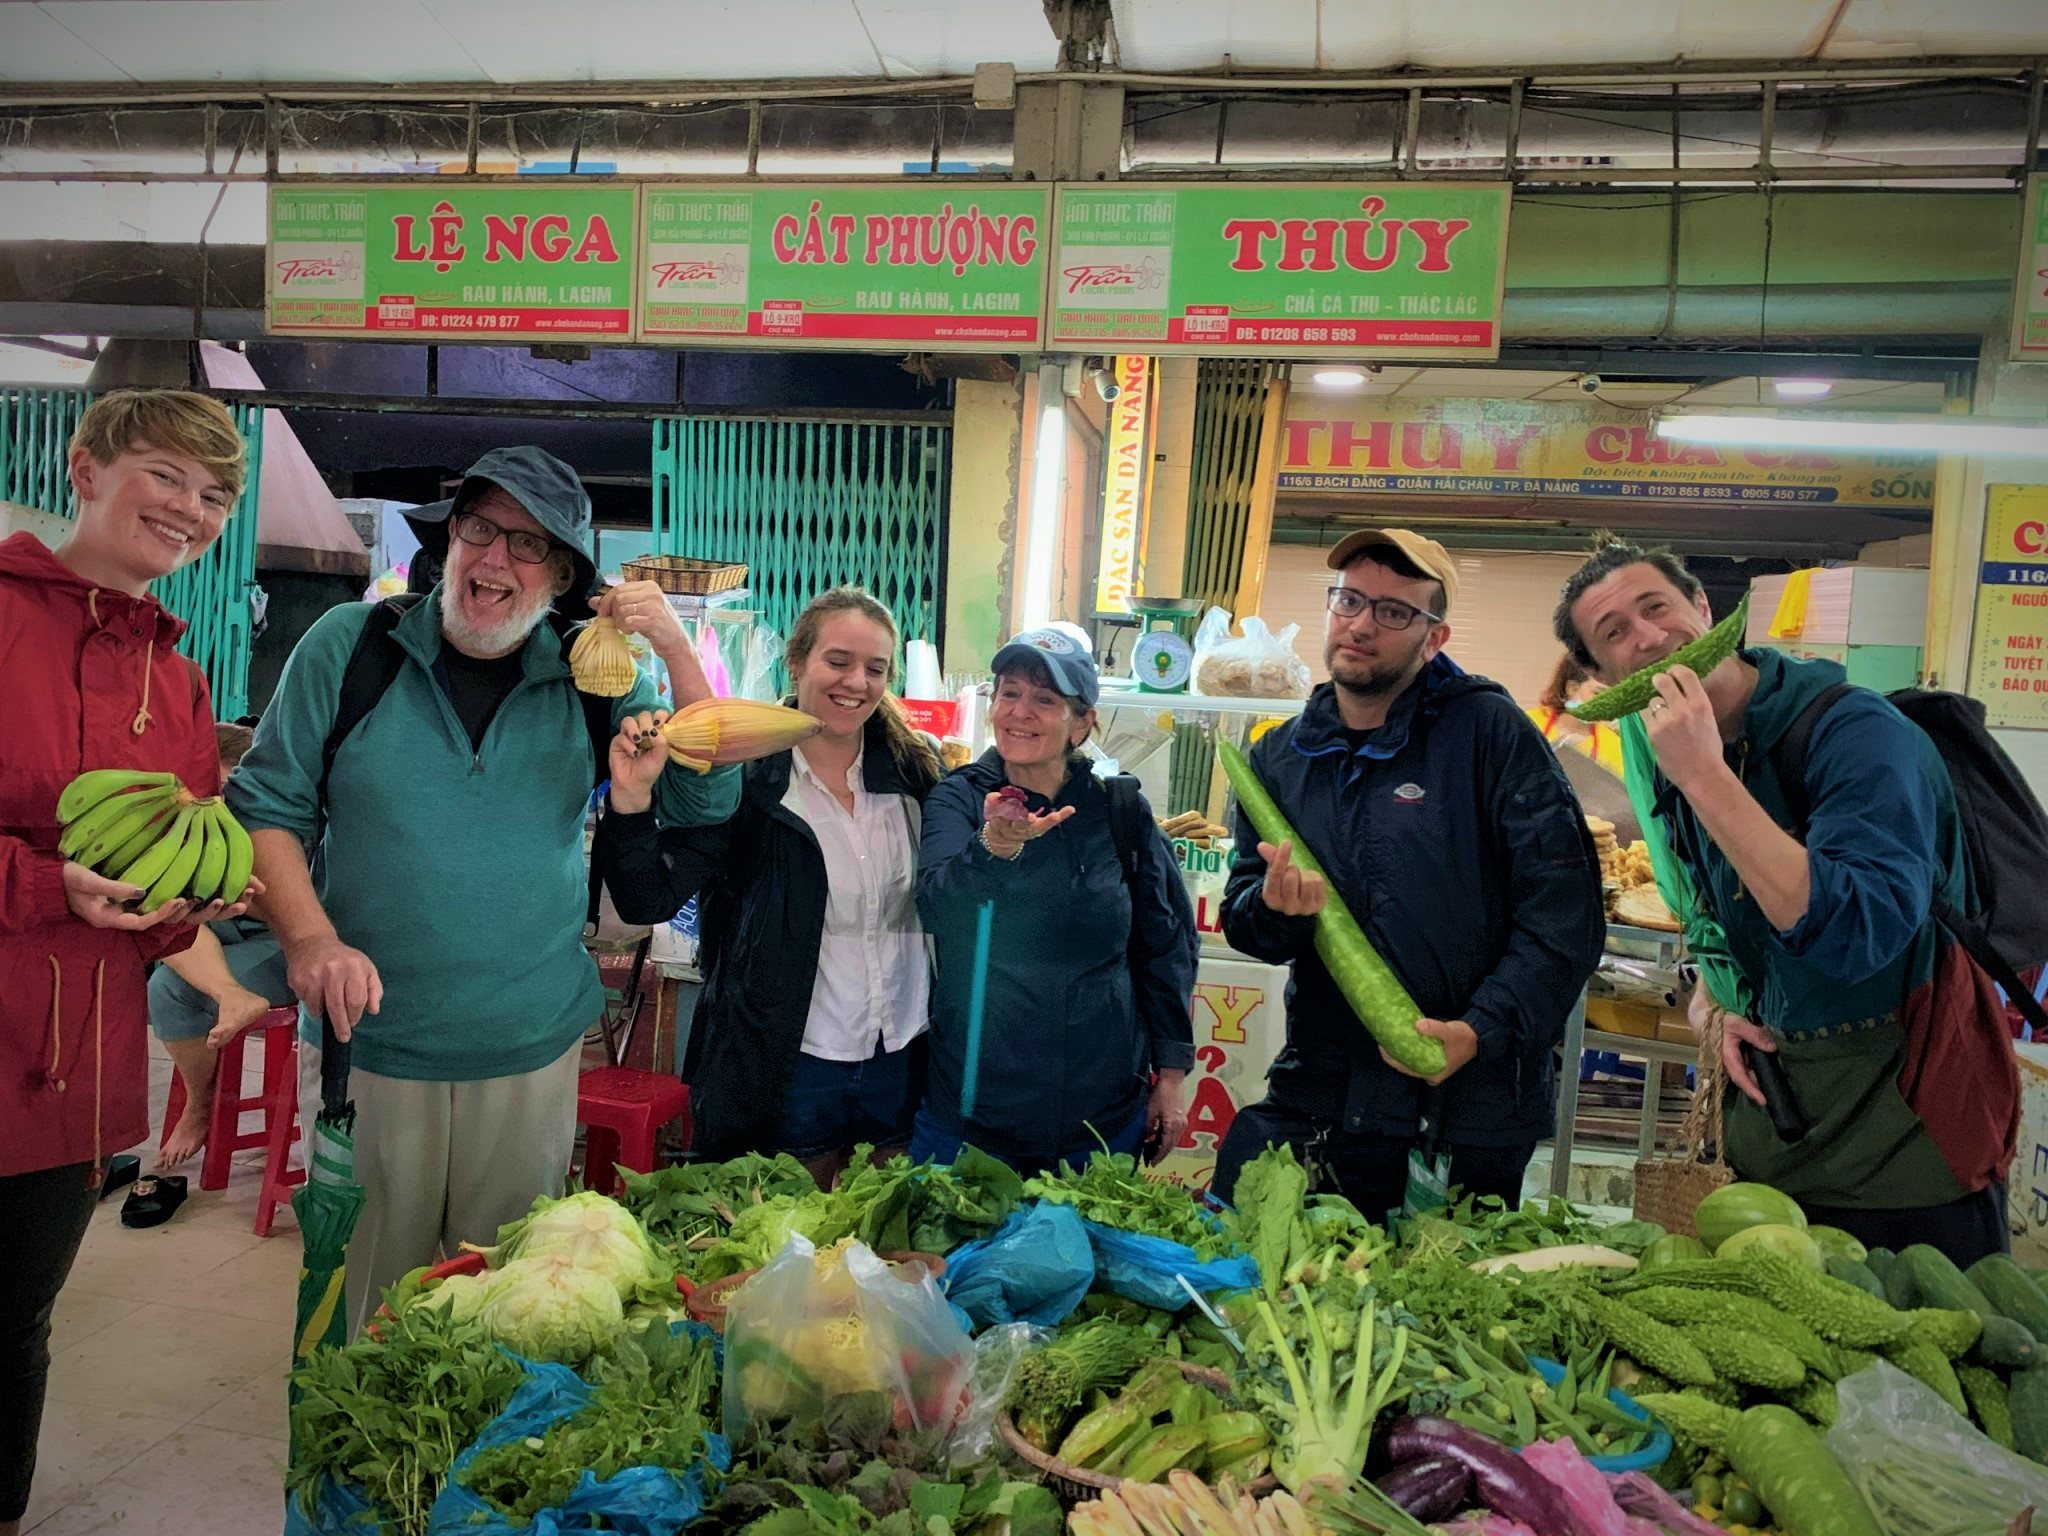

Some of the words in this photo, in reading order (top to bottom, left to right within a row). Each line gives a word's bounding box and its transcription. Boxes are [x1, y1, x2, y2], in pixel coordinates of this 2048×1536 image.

[392, 200, 466, 273] LỆ
[482, 214, 620, 264] NGA
[773, 200, 855, 266] CÁT
[865, 203, 1038, 277] PHƯỢNG
[1222, 195, 1470, 272] THỦY
[463, 286, 496, 302] RAU
[559, 286, 612, 304] LAGIM
[855, 291, 893, 309] RAU
[898, 288, 955, 312] HÀNH,
[962, 292, 1020, 311] LAGIM
[1350, 295, 1380, 314] THU
[441, 314, 473, 328] 01224
[476, 315, 496, 328] 479
[499, 315, 520, 328] 877
[1261, 328, 1300, 340] 01208
[1303, 328, 1327, 341] 658
[1331, 328, 1357, 342] 593
[1504, 480, 1520, 491] TP.
[1648, 485, 1676, 496] 0120
[1742, 489, 1770, 499] 0905
[1773, 490, 1794, 499] 450
[1798, 490, 1820, 500] 577
